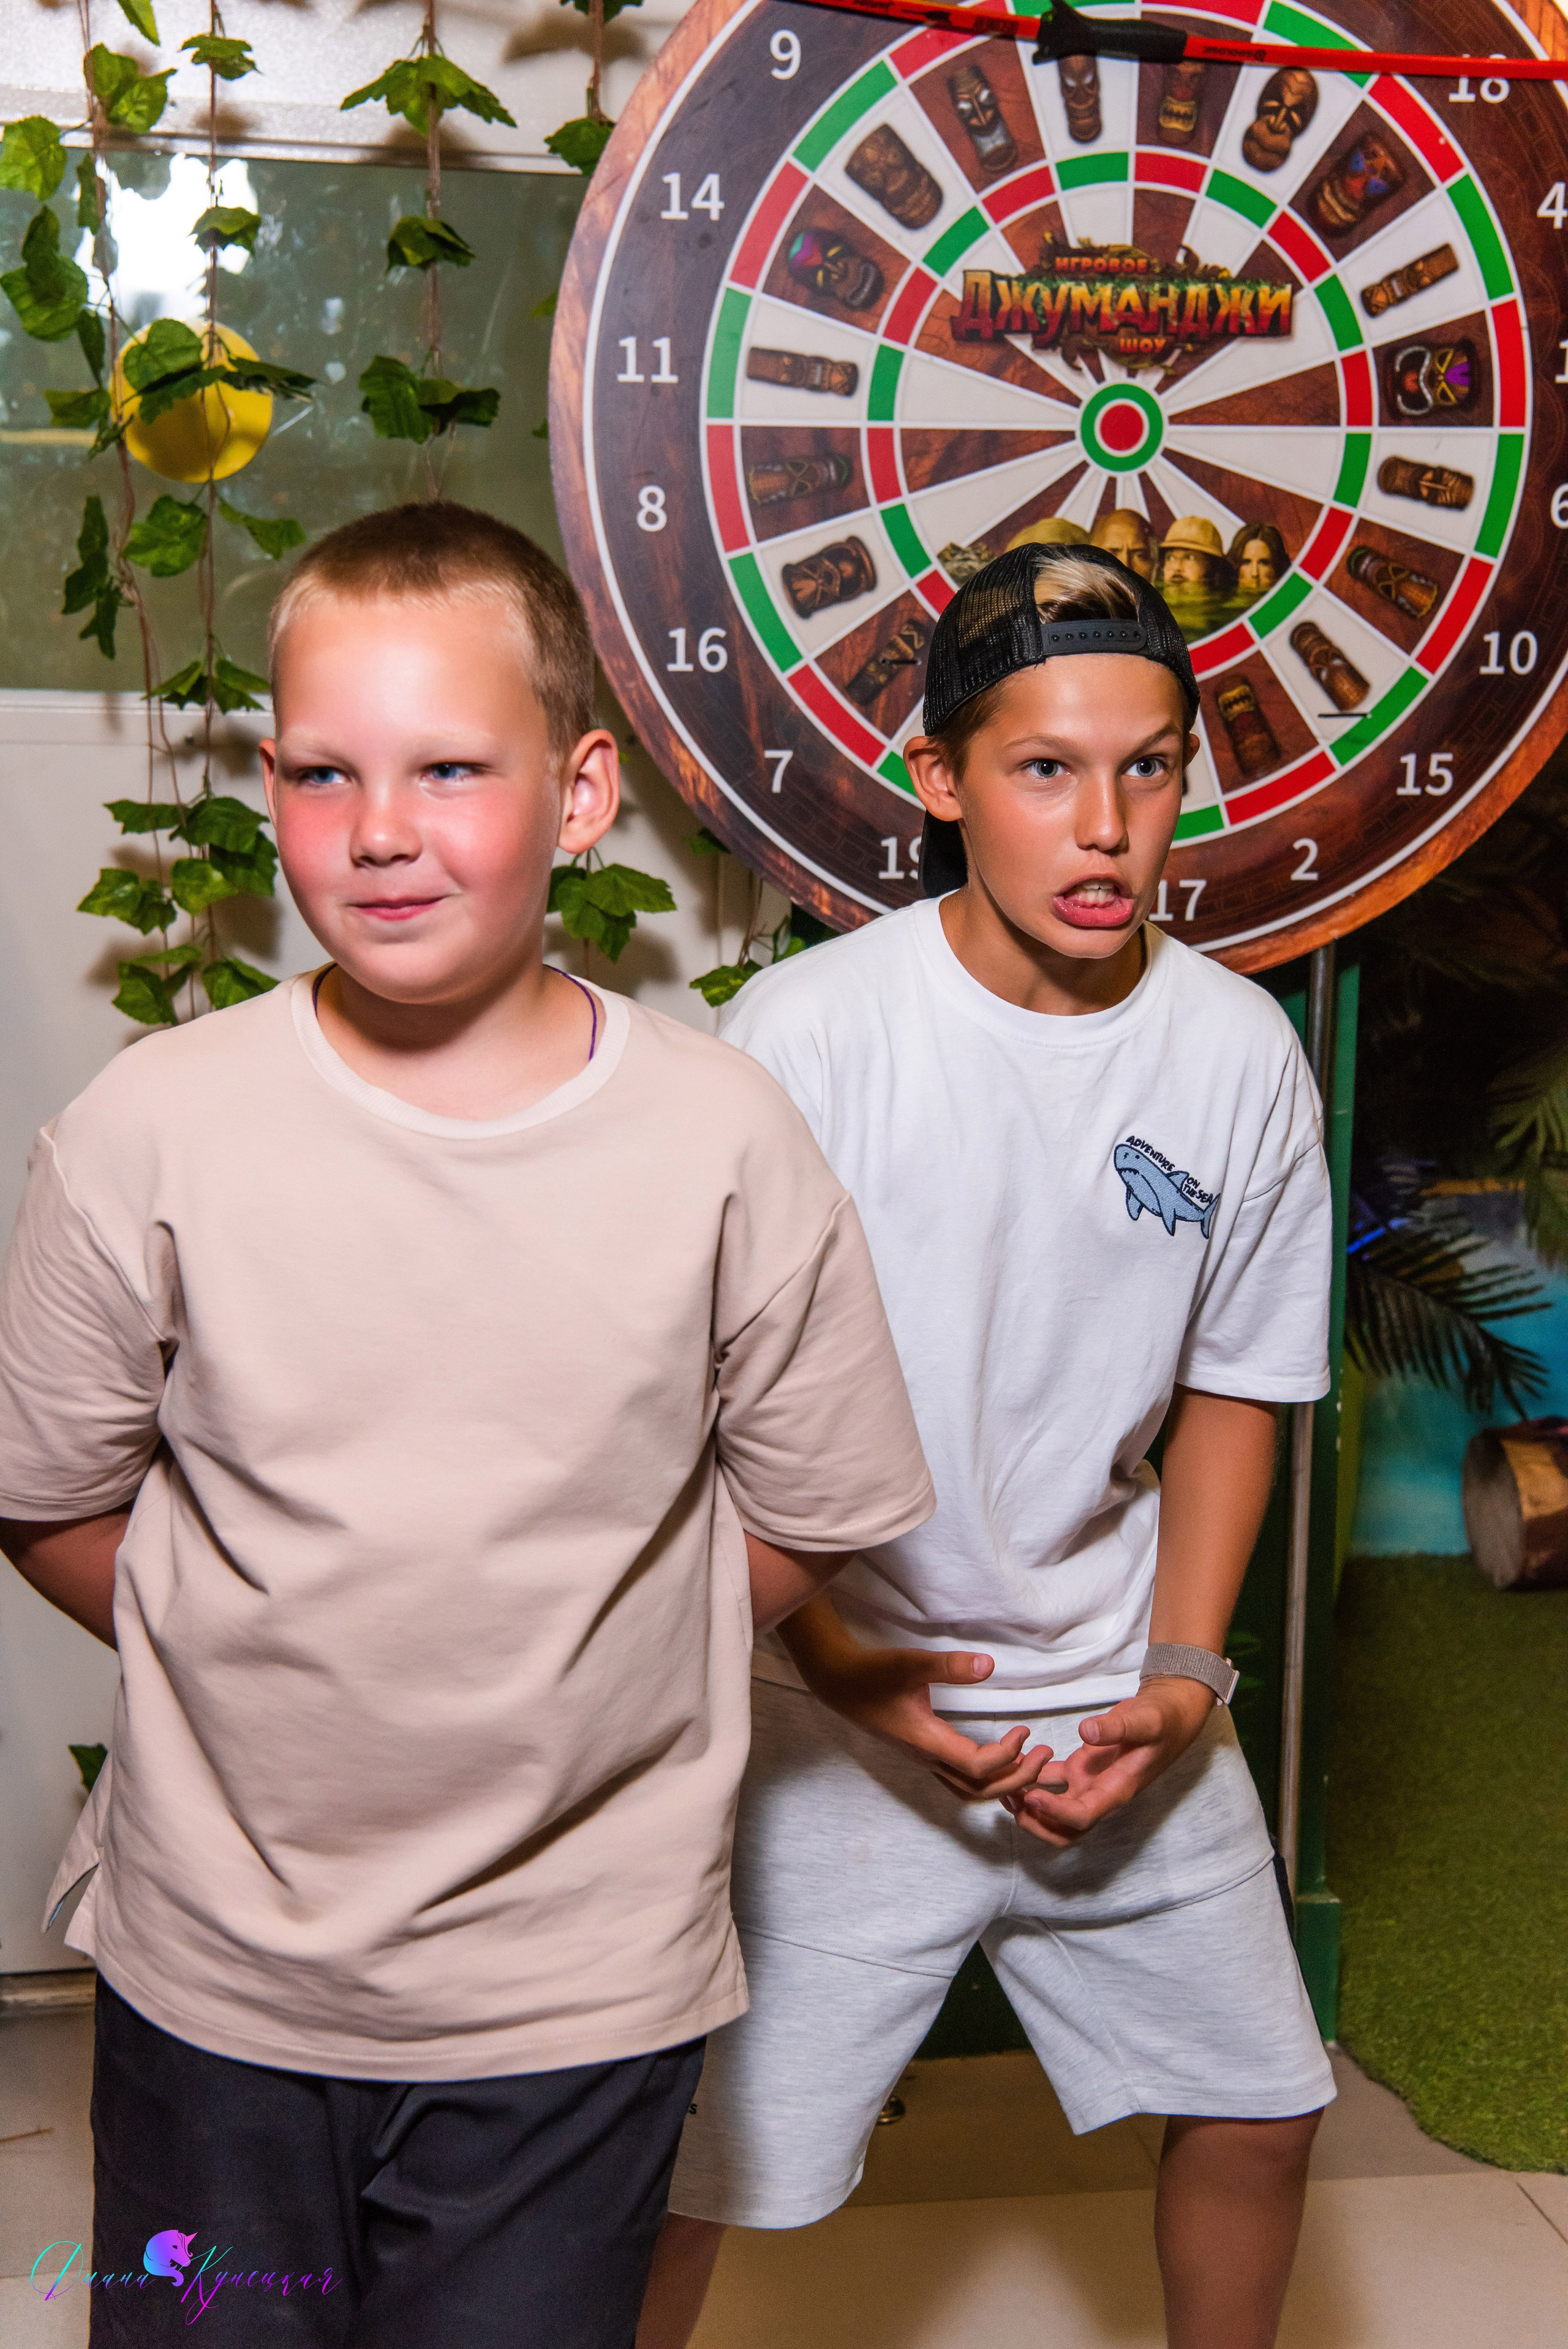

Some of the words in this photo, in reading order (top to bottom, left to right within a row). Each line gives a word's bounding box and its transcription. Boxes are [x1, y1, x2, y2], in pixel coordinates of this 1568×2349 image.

[769, 29, 802, 80] 9
[660, 172, 725, 221] 14
[1536, 181, 1568, 229] 4
[1055, 256, 1148, 274] ИГРОВОЕ
[950, 270, 1292, 350] ДЖУМАНДЖИ
[616, 335, 679, 384] 11
[1118, 337, 1166, 354] ШОУ
[636, 485, 668, 532] 8
[666, 627, 728, 673] 16
[1479, 631, 1538, 674] 10
[763, 749, 794, 793] 7
[1396, 753, 1453, 796] 15
[1291, 838, 1319, 881] 2
[1148, 878, 1207, 922] 17
[1125, 1135, 1175, 1171] ADVENTURE
[1186, 1177, 1200, 1190] ON
